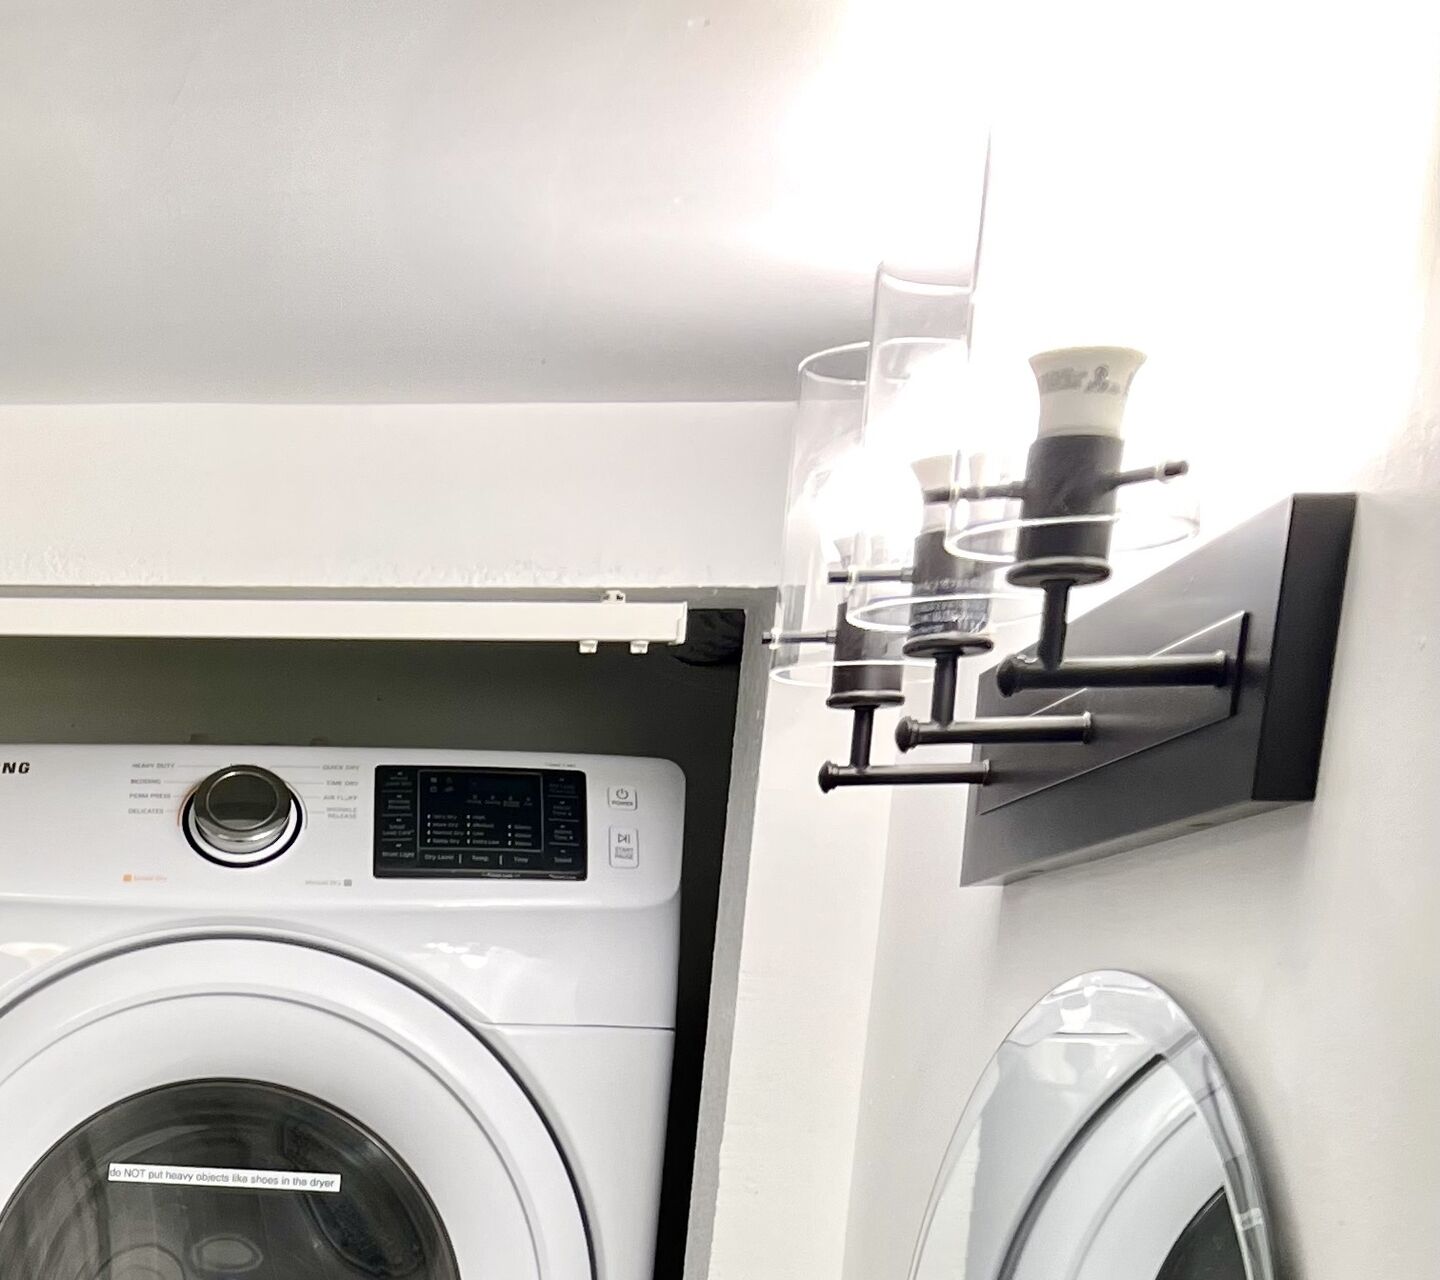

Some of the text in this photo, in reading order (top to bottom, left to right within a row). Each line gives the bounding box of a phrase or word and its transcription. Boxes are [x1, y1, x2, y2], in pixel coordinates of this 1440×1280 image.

[124, 1168, 145, 1179] NOT
[148, 1171, 163, 1182] put
[165, 1171, 193, 1183] heavy
[196, 1173, 229, 1185] objects
[232, 1174, 248, 1183] like
[251, 1175, 279, 1186] shoes
[281, 1177, 290, 1186] in
[292, 1177, 307, 1187] the
[310, 1178, 335, 1189] dryer
